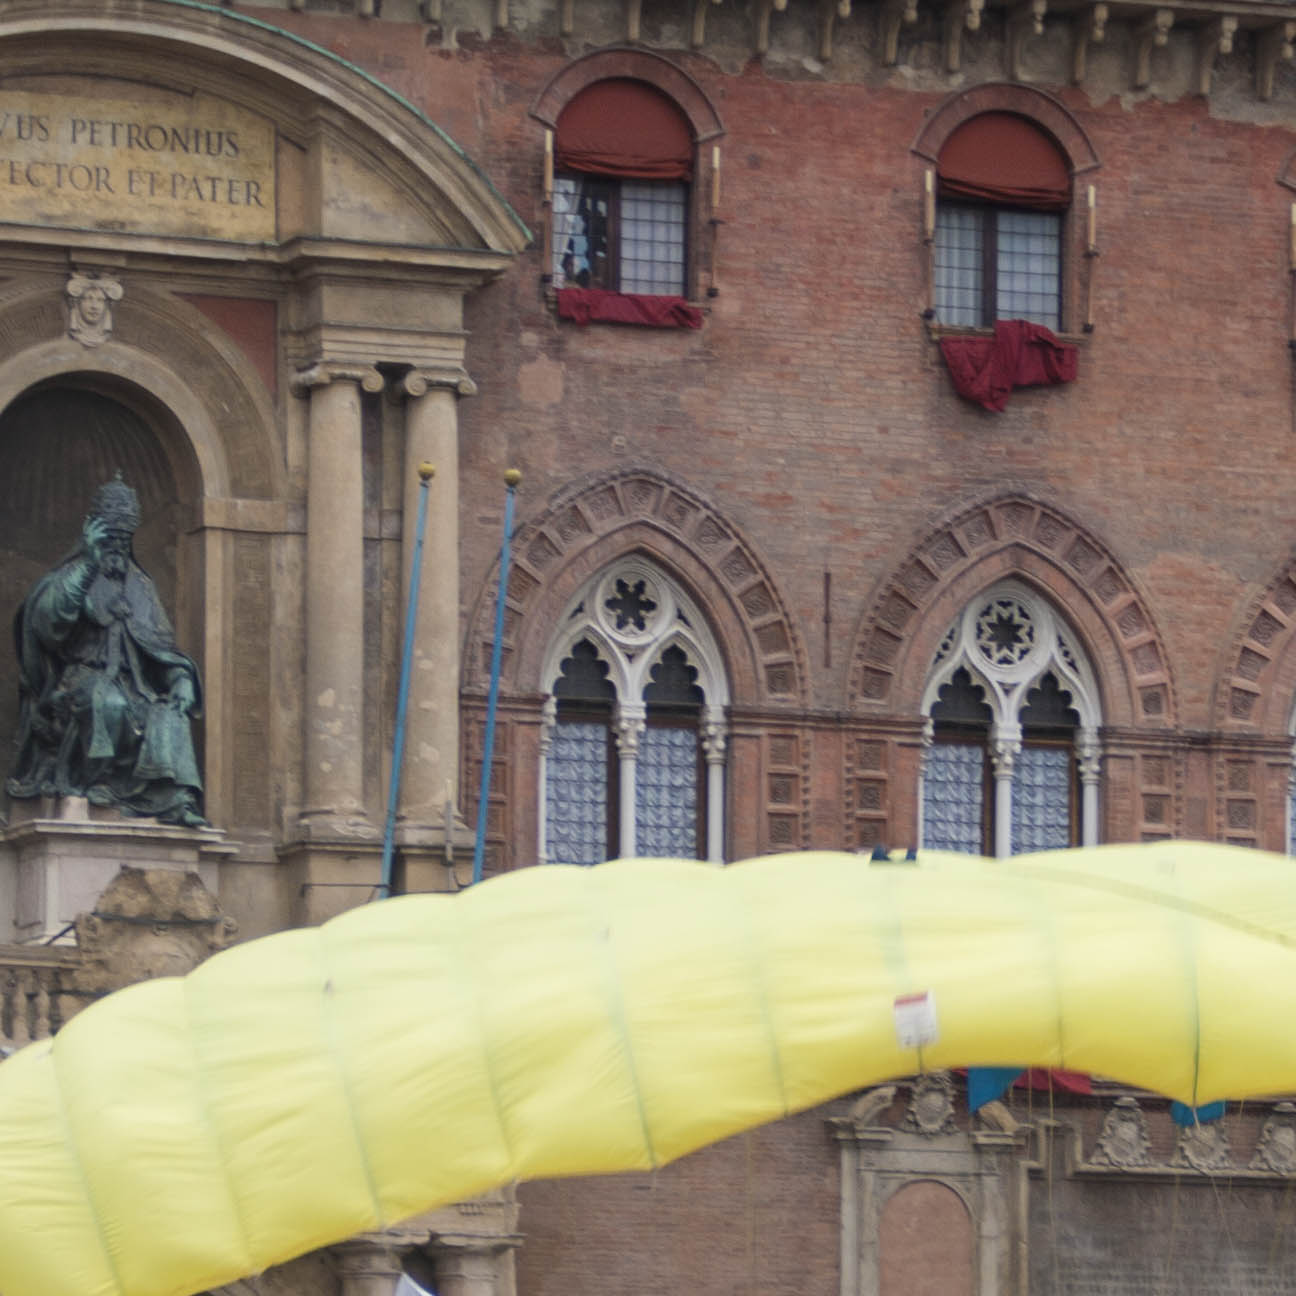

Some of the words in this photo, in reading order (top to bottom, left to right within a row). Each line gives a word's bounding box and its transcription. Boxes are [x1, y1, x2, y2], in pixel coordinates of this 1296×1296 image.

[71, 118, 241, 158] PETRONIUS
[128, 169, 159, 197] ET
[171, 172, 265, 208] PATER
